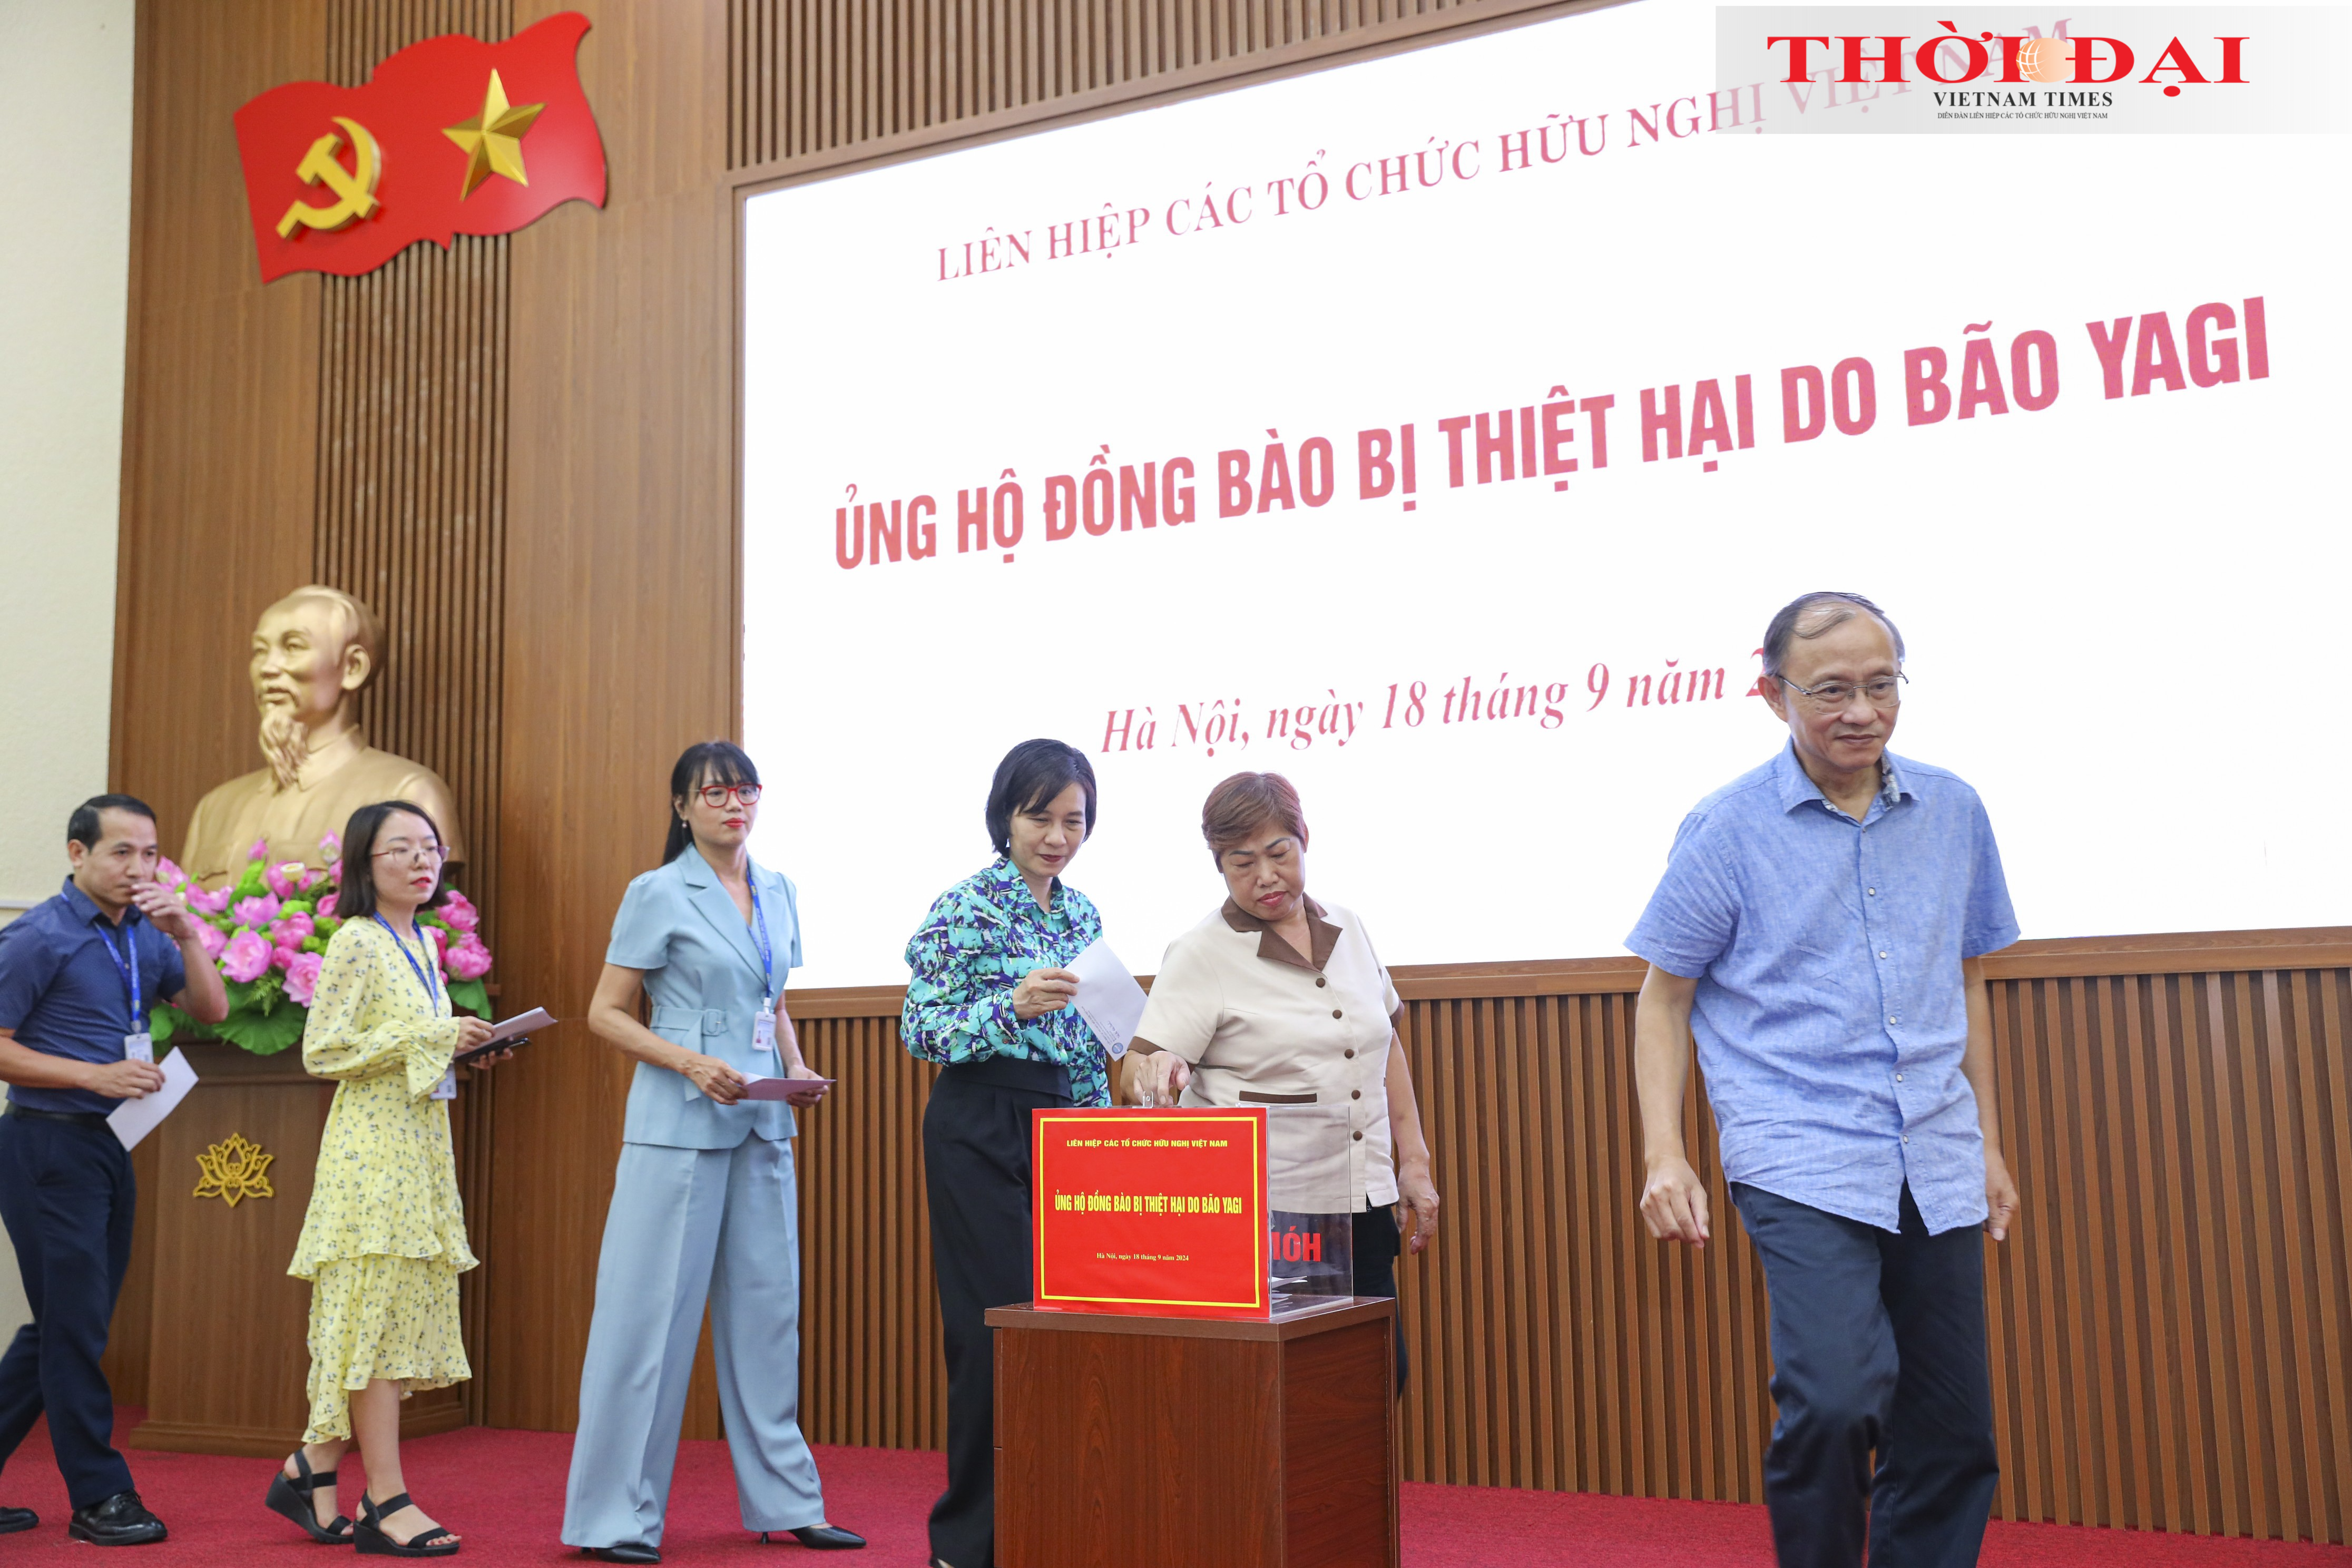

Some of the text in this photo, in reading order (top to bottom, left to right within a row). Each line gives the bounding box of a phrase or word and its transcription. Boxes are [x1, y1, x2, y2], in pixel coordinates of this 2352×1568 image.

[937, 227, 1032, 281] LIÊN
[1047, 202, 1151, 259] HIỆP
[1165, 183, 1253, 236] CÁC
[1267, 149, 1329, 215] TỔ
[1345, 136, 1481, 201] CHỨC
[1497, 113, 1610, 172] HỮU
[1626, 83, 1765, 148] NGHỊ
[836, 295, 2270, 570] ỦNG HỘ ĐỒNG BÀO BỊ THIỆT HẠI DO BÃO YAGI
[1101, 706, 1157, 753] Hà
[1171, 698, 1250, 758] Nội,
[1266, 688, 1364, 750] ngày
[1381, 680, 1427, 729] 18
[1443, 672, 1569, 730] tháng
[1586, 662, 1610, 713] 9
[1626, 660, 1726, 709] năm
[1066, 1139, 1083, 1147] LIÊN
[1084, 1139, 1102, 1148] HIỆP
[1104, 1139, 1119, 1147] CÁC
[1132, 1139, 1152, 1147] CHỨC
[1153, 1139, 1169, 1147] HỮU
[1171, 1140, 1190, 1149] NGHỊ
[1191, 1139, 1208, 1149] VIỆT
[1055, 1189, 1242, 1217] ỦNG HỘ ĐỒNG BÀO BỊ THIỆT HẠI DO BÃO YAGI
